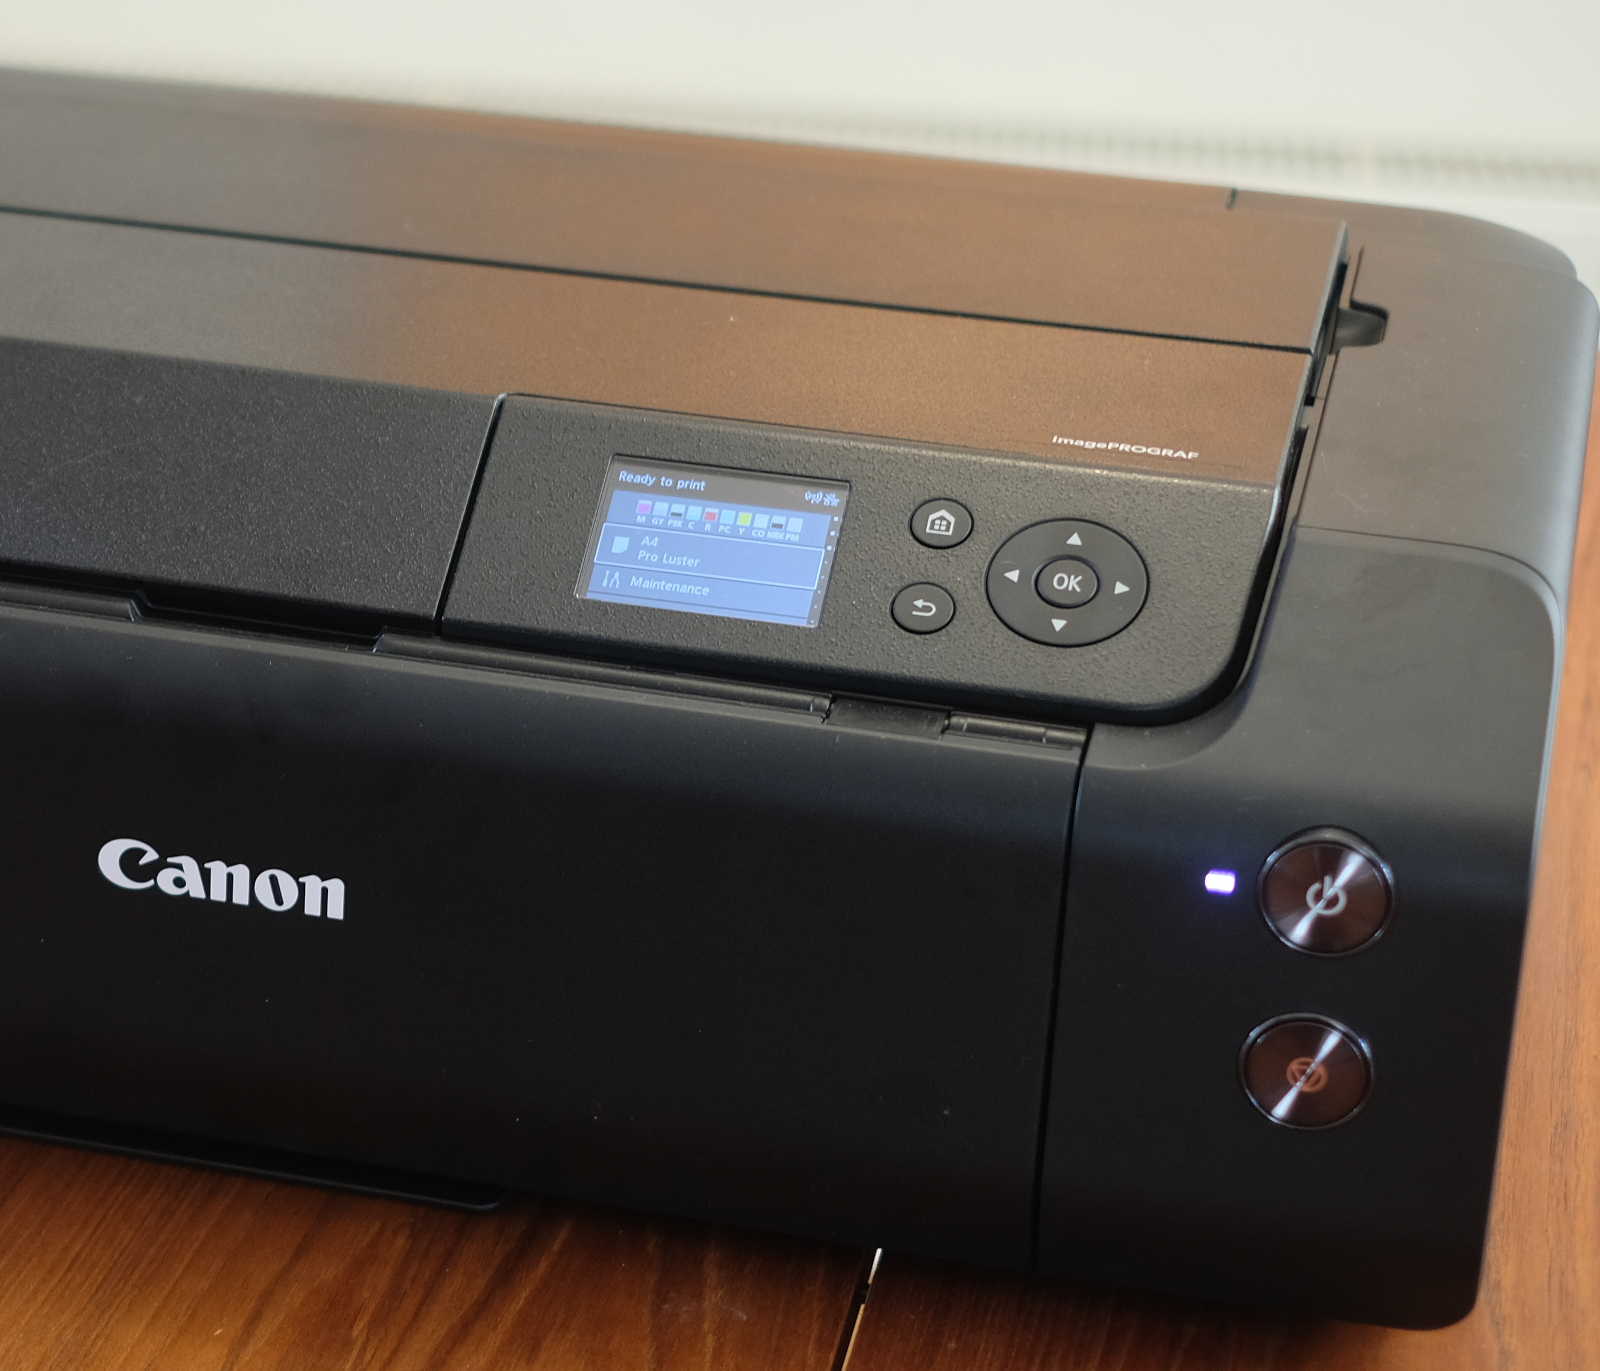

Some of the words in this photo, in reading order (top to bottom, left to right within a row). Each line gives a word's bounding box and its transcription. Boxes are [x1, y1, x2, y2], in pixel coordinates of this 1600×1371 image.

[619, 470, 656, 486] Ready
[660, 476, 673, 487] to
[676, 478, 706, 491] print
[636, 515, 646, 523] M
[652, 517, 664, 525] GY
[688, 521, 695, 530] C
[718, 525, 731, 533] PC
[738, 527, 745, 535] Y
[751, 528, 765, 538] CO
[785, 533, 799, 542] PM
[640, 535, 658, 547] A4
[637, 549, 658, 563] Pro
[662, 553, 700, 567] Luster
[630, 575, 710, 596] Maintenance
[1052, 572, 1083, 593] OK
[98, 838, 345, 920] Canon
